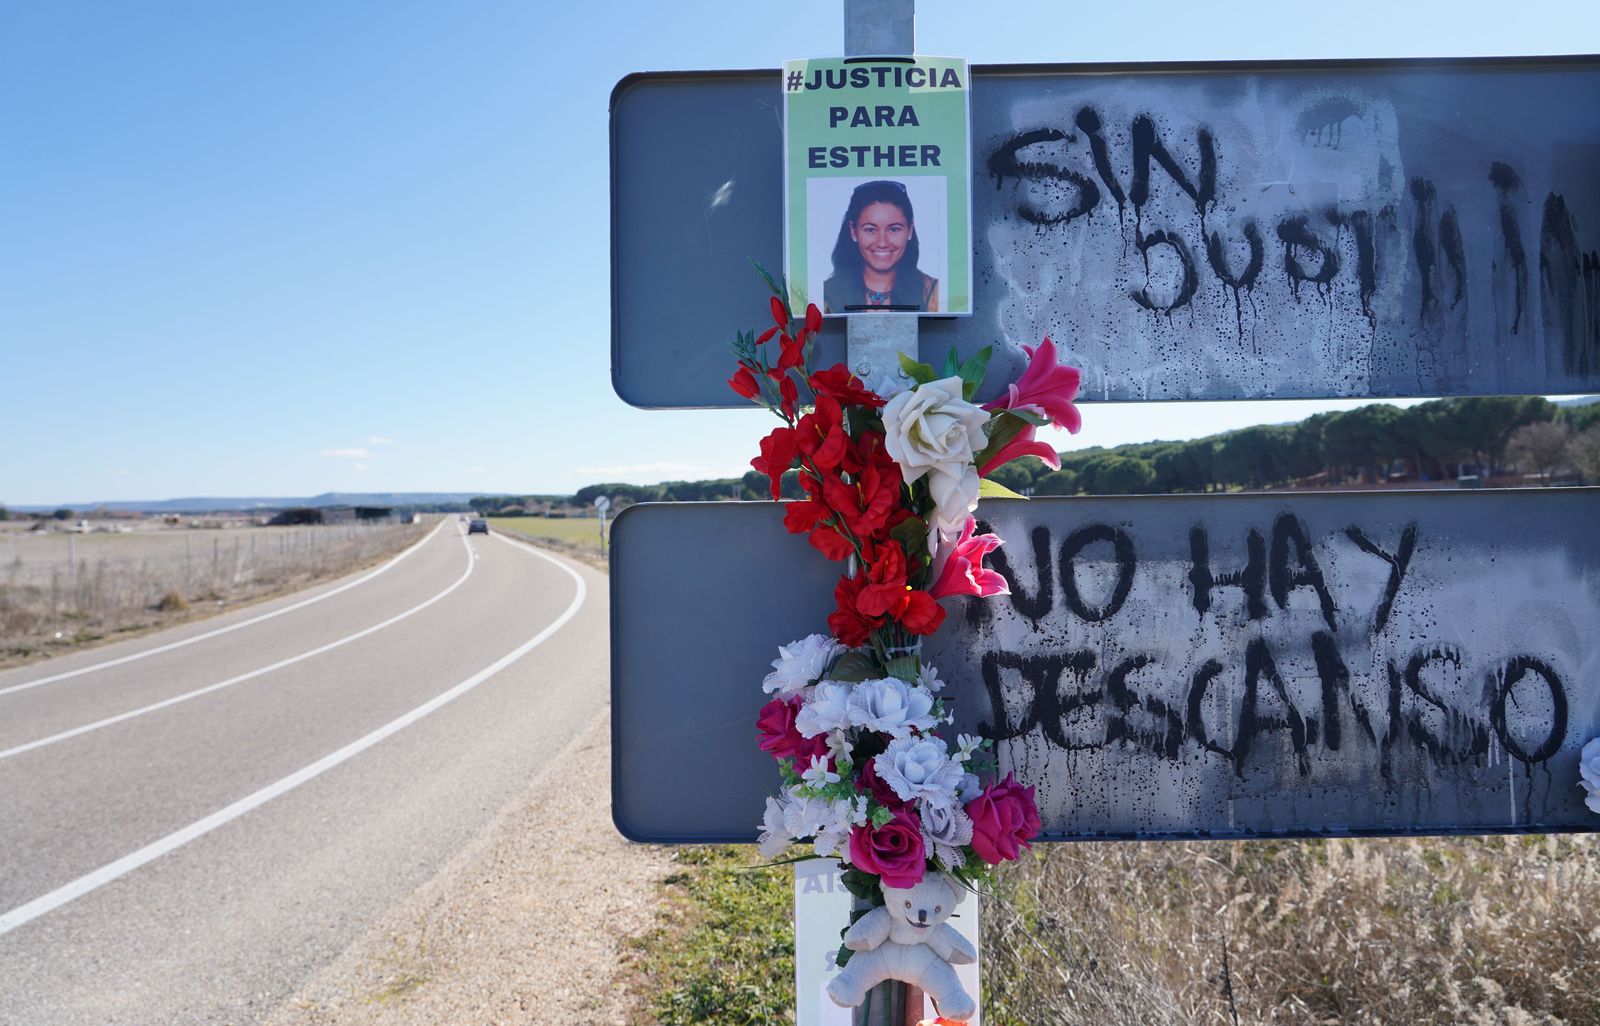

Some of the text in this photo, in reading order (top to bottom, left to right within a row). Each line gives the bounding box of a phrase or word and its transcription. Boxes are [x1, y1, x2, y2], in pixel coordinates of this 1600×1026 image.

[787, 67, 962, 91] #JUSTICIA
[829, 105, 920, 128] PARA
[808, 144, 941, 169] ESTHER
[988, 106, 1217, 224] SIN
[964, 512, 1419, 633] NO HAY
[978, 631, 1568, 778] DESCANSO
